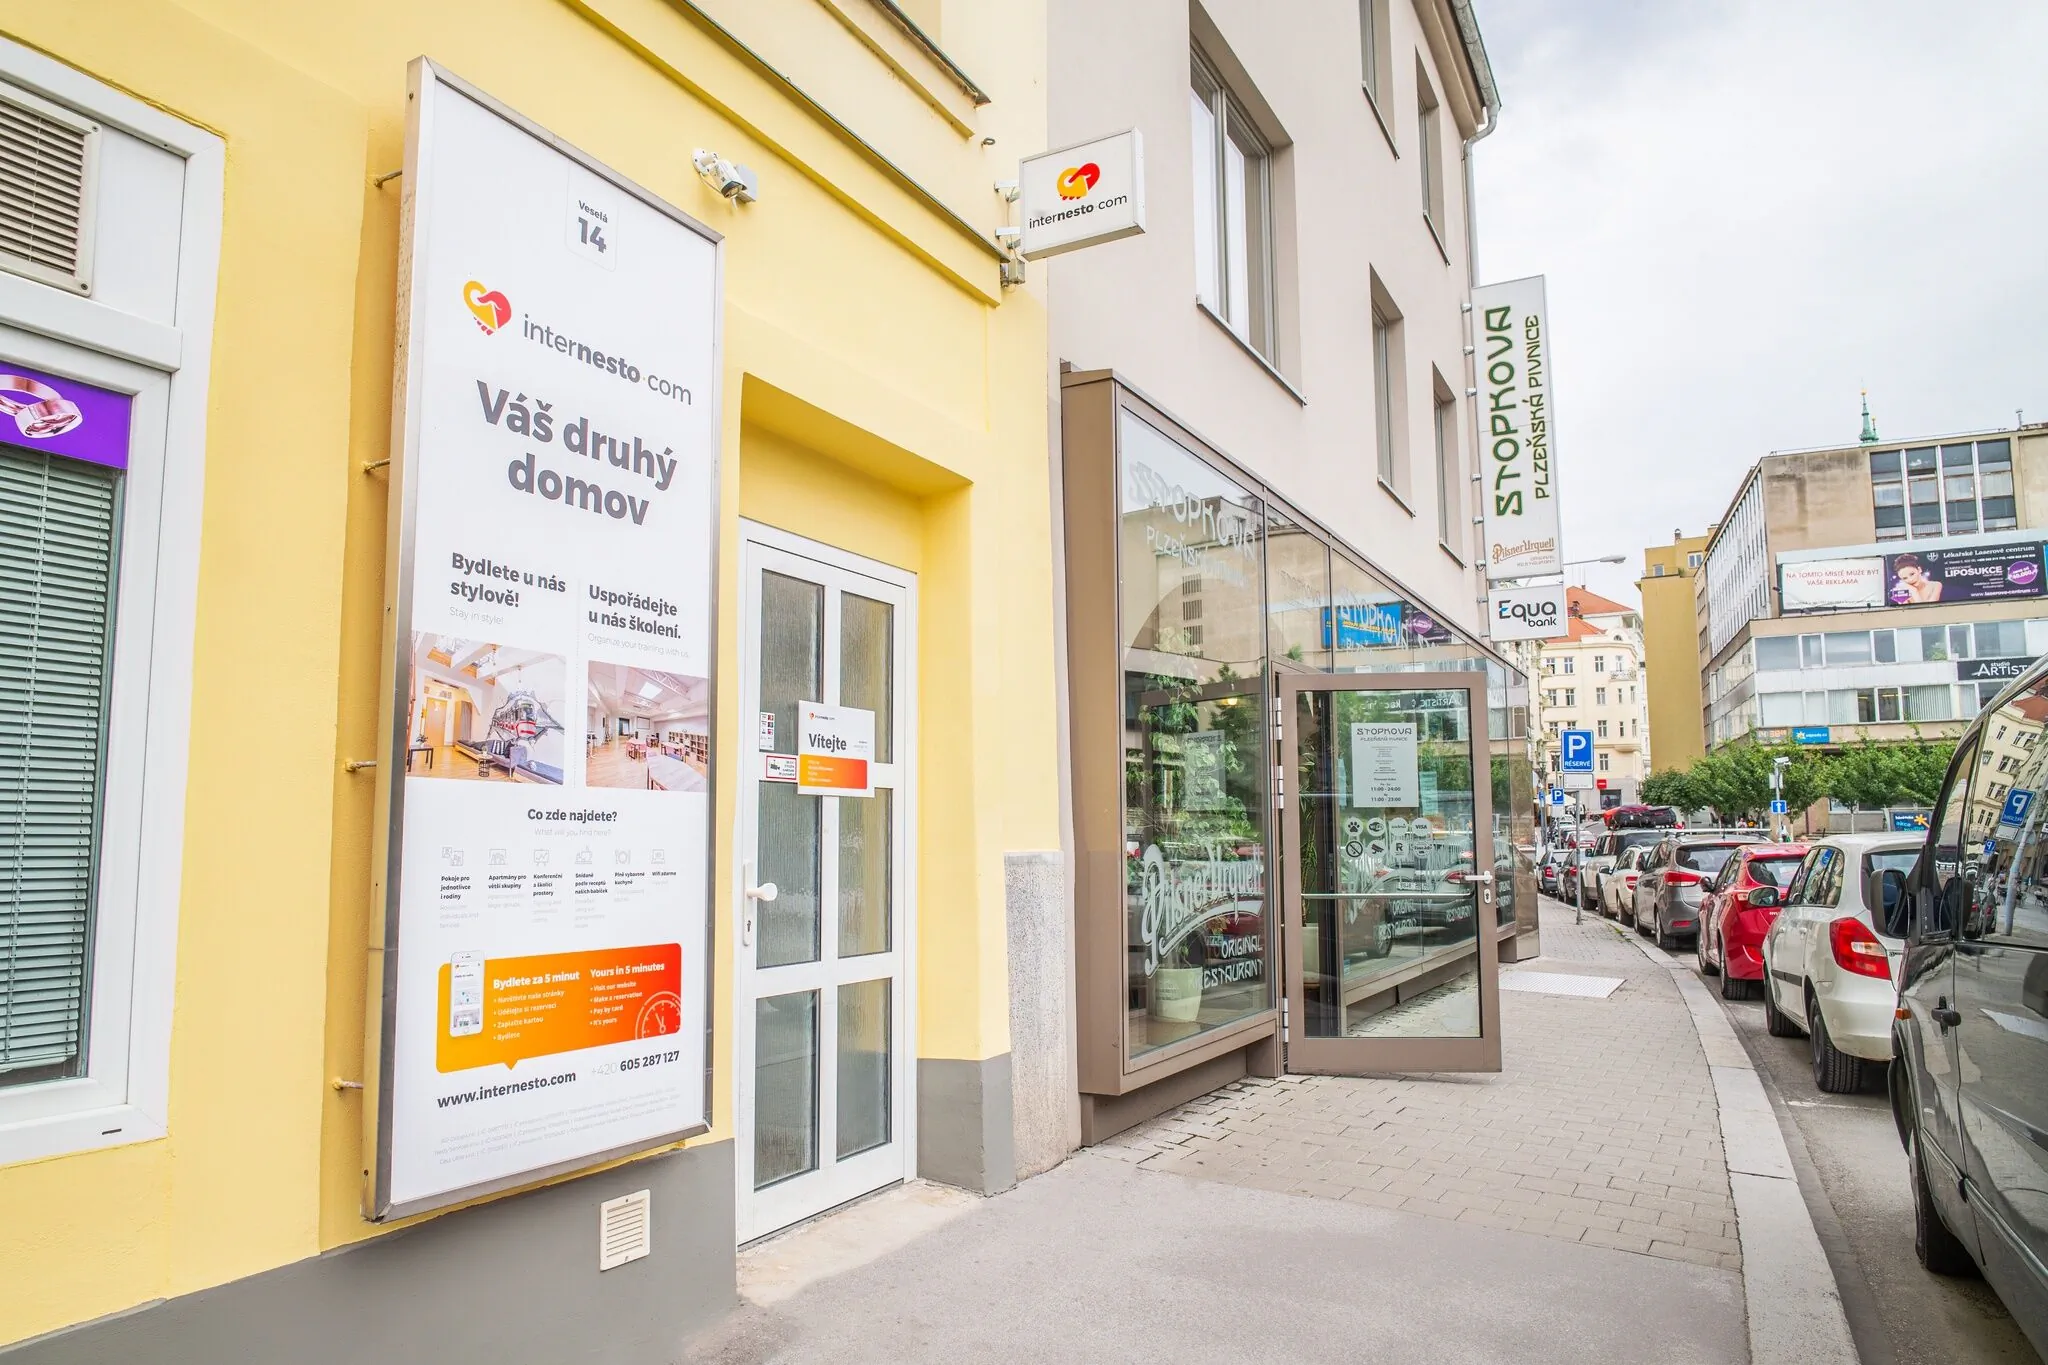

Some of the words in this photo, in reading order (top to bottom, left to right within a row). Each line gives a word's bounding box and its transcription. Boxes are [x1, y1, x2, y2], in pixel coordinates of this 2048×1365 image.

[579, 200, 608, 223] Veselá
[578, 217, 606, 253] 14
[1525, 315, 1543, 388] PIVNICE
[1485, 305, 1523, 516] STOPKOVA
[476, 380, 553, 443] Váš
[563, 417, 677, 491] druhý
[1522, 397, 1550, 499] PLZEŇSKÁ
[508, 453, 649, 526] domov
[1492, 543, 1525, 564] Pilsner
[1523, 537, 1554, 554] Urquell
[1943, 550, 1973, 558] Lékařské
[1975, 548, 2004, 556] Laserové
[452, 552, 520, 583] Bydlete
[523, 573, 534, 586] u
[538, 574, 566, 593] nás
[1944, 566, 2003, 578] LIPOSUKCE
[450, 580, 520, 608] stylově!
[588, 583, 678, 617] Uspořádejte
[449, 606, 469, 621] Stay
[481, 613, 504, 625] style!
[1498, 600, 1557, 622] Equa
[1528, 616, 1557, 627] bank
[588, 610, 598, 623] u
[601, 609, 627, 629] nás
[628, 615, 682, 640] školení.
[1356, 727, 1412, 735] STOPKOVA
[808, 733, 847, 753] Vítejte
[1568, 735, 1587, 759] P
[1564, 759, 1591, 767] RÉSERVÉ
[1554, 790, 1562, 801] P
[527, 808, 544, 821] Co
[545, 808, 567, 821] zde
[569, 809, 618, 824] najdete?
[440, 884, 471, 892] jednotlivce
[488, 874, 517, 882] Apartmány
[518, 874, 527, 882] pro
[501, 882, 522, 890] skupiny
[1221, 935, 1264, 960] ORIGINAL
[493, 976, 531, 991] Bydlete
[532, 975, 543, 985] za
[544, 973, 551, 984] 5
[552, 971, 580, 983] minut
[590, 968, 615, 978] Yours
[615, 965, 624, 975] in
[625, 965, 631, 974] 5
[631, 963, 665, 974] minutes
[1195, 958, 1264, 991] RESTAURANT
[542, 989, 565, 999] stránky
[613, 991, 643, 1000] reservation
[523, 1016, 544, 1025] kartou
[593, 1007, 604, 1016] Pay
[591, 1062, 617, 1077] +420
[619, 1058, 641, 1073] 605
[642, 1053, 662, 1069] 287
[663, 1050, 680, 1065] 127
[437, 1071, 577, 1109] www.internesto.com
